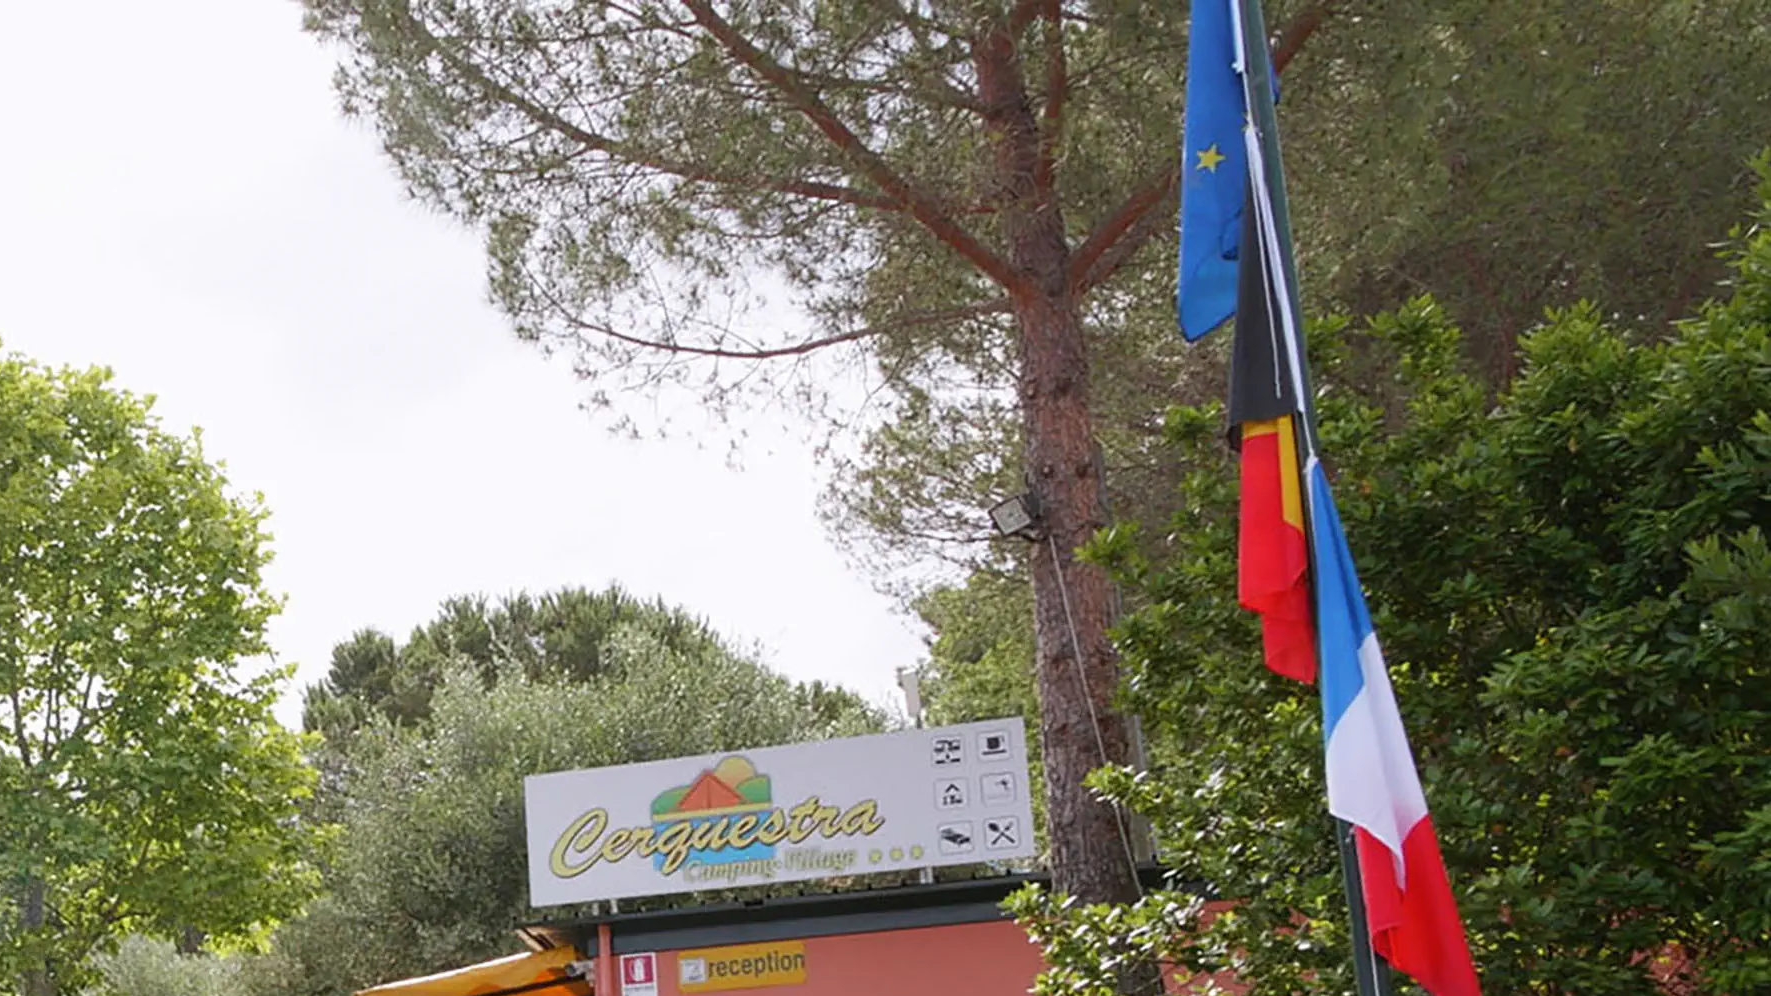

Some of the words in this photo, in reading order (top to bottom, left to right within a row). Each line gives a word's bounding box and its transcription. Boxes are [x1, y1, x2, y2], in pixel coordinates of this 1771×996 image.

[549, 796, 885, 878] Cerquestra
[684, 857, 778, 882] Camping
[782, 847, 858, 872] Village
[709, 951, 805, 977] reception
